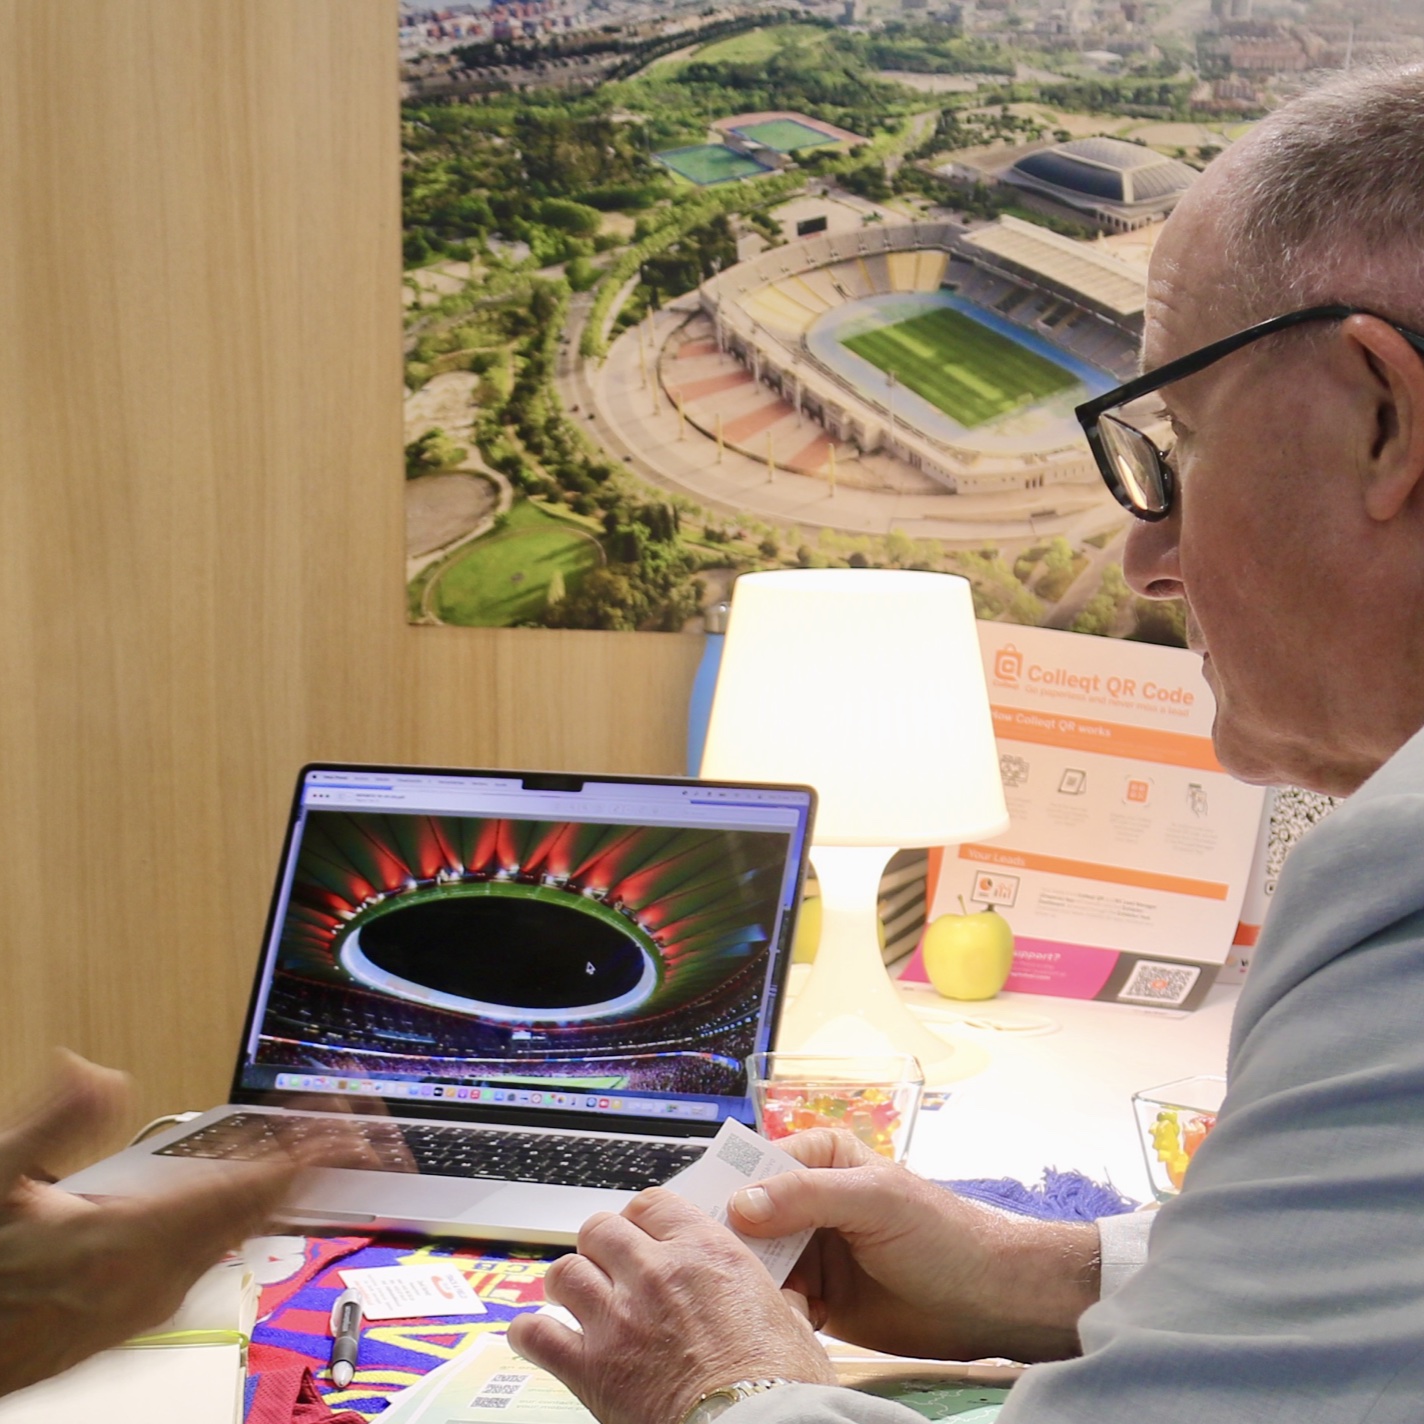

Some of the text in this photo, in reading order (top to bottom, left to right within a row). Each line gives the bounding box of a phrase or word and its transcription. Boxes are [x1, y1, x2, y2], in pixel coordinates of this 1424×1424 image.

[1027, 664, 1195, 706] Colleqt QR Code
[1088, 693, 1107, 705] and
[1059, 718, 1076, 732] QR
[1079, 724, 1112, 738] works
[967, 848, 1026, 867] Your Leads
